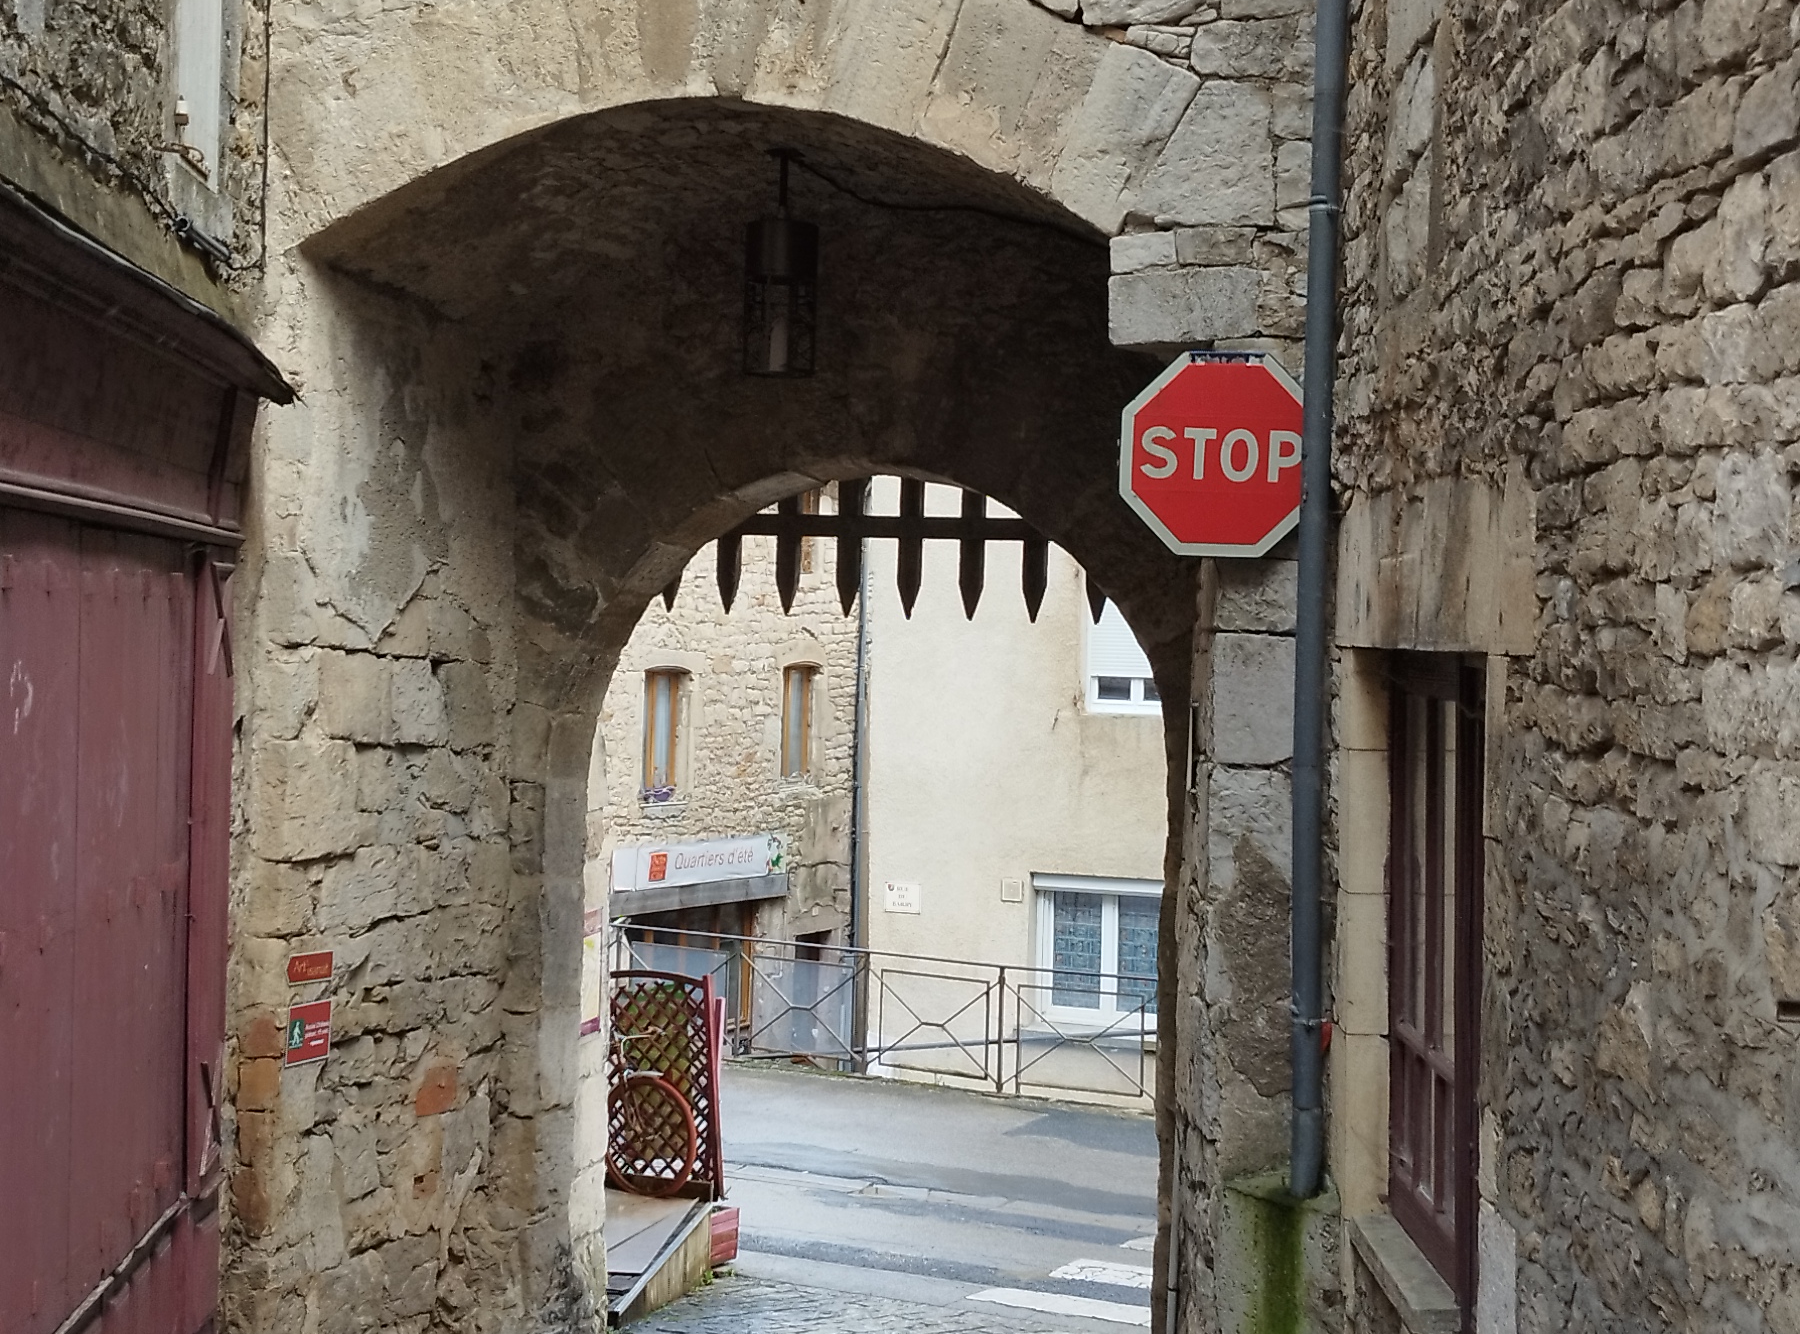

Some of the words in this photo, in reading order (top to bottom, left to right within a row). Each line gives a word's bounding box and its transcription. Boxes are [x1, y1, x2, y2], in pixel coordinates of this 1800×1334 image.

[1140, 425, 1303, 483] STOP
[675, 851, 724, 870] Quartiers
[728, 846, 754, 865] d'été
